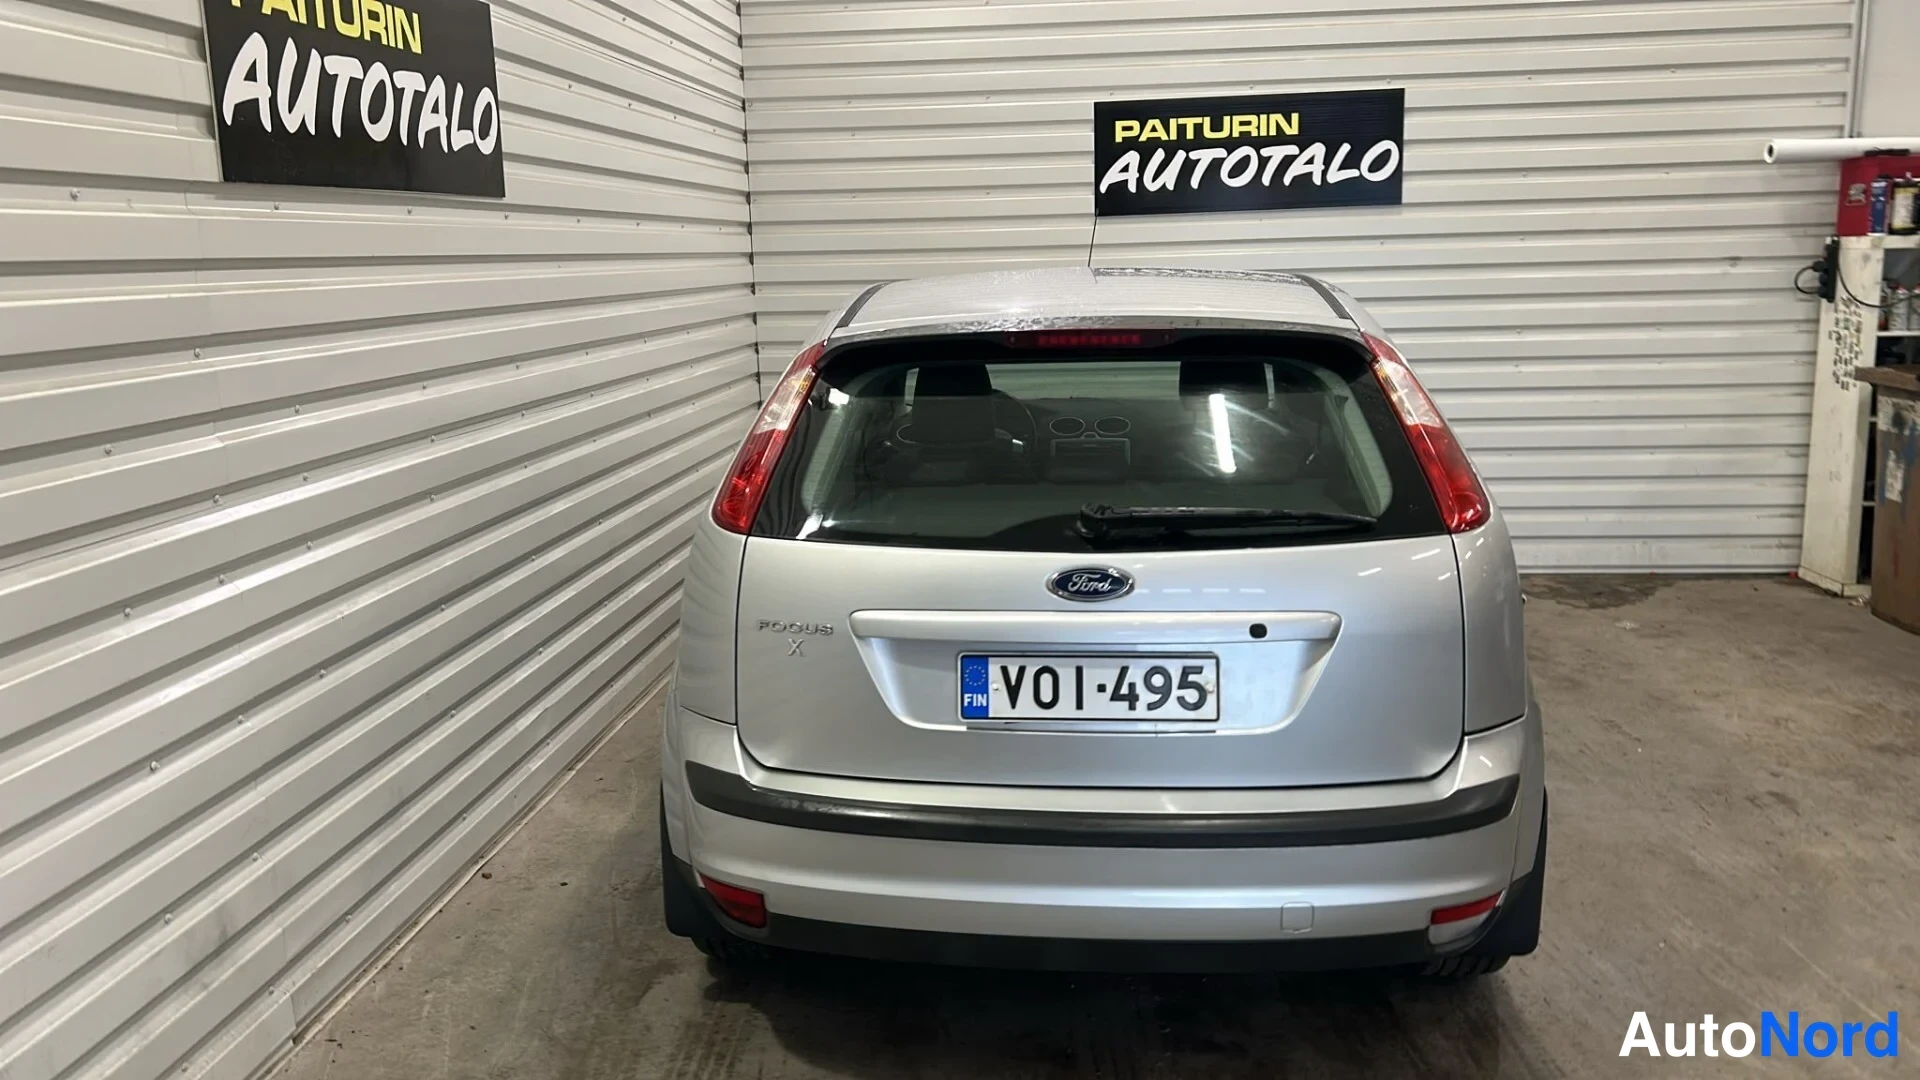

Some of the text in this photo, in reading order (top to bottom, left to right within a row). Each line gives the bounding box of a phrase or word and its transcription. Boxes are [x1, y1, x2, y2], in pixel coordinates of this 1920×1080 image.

[222, 31, 498, 155] AUTOTALO
[1115, 112, 1299, 143] PAITURIN
[1099, 139, 1400, 194] AUTOTALO
[1068, 573, 1112, 592] Ford
[758, 620, 834, 636] FOCUS
[787, 638, 805, 657] X
[963, 693, 987, 707] FIN
